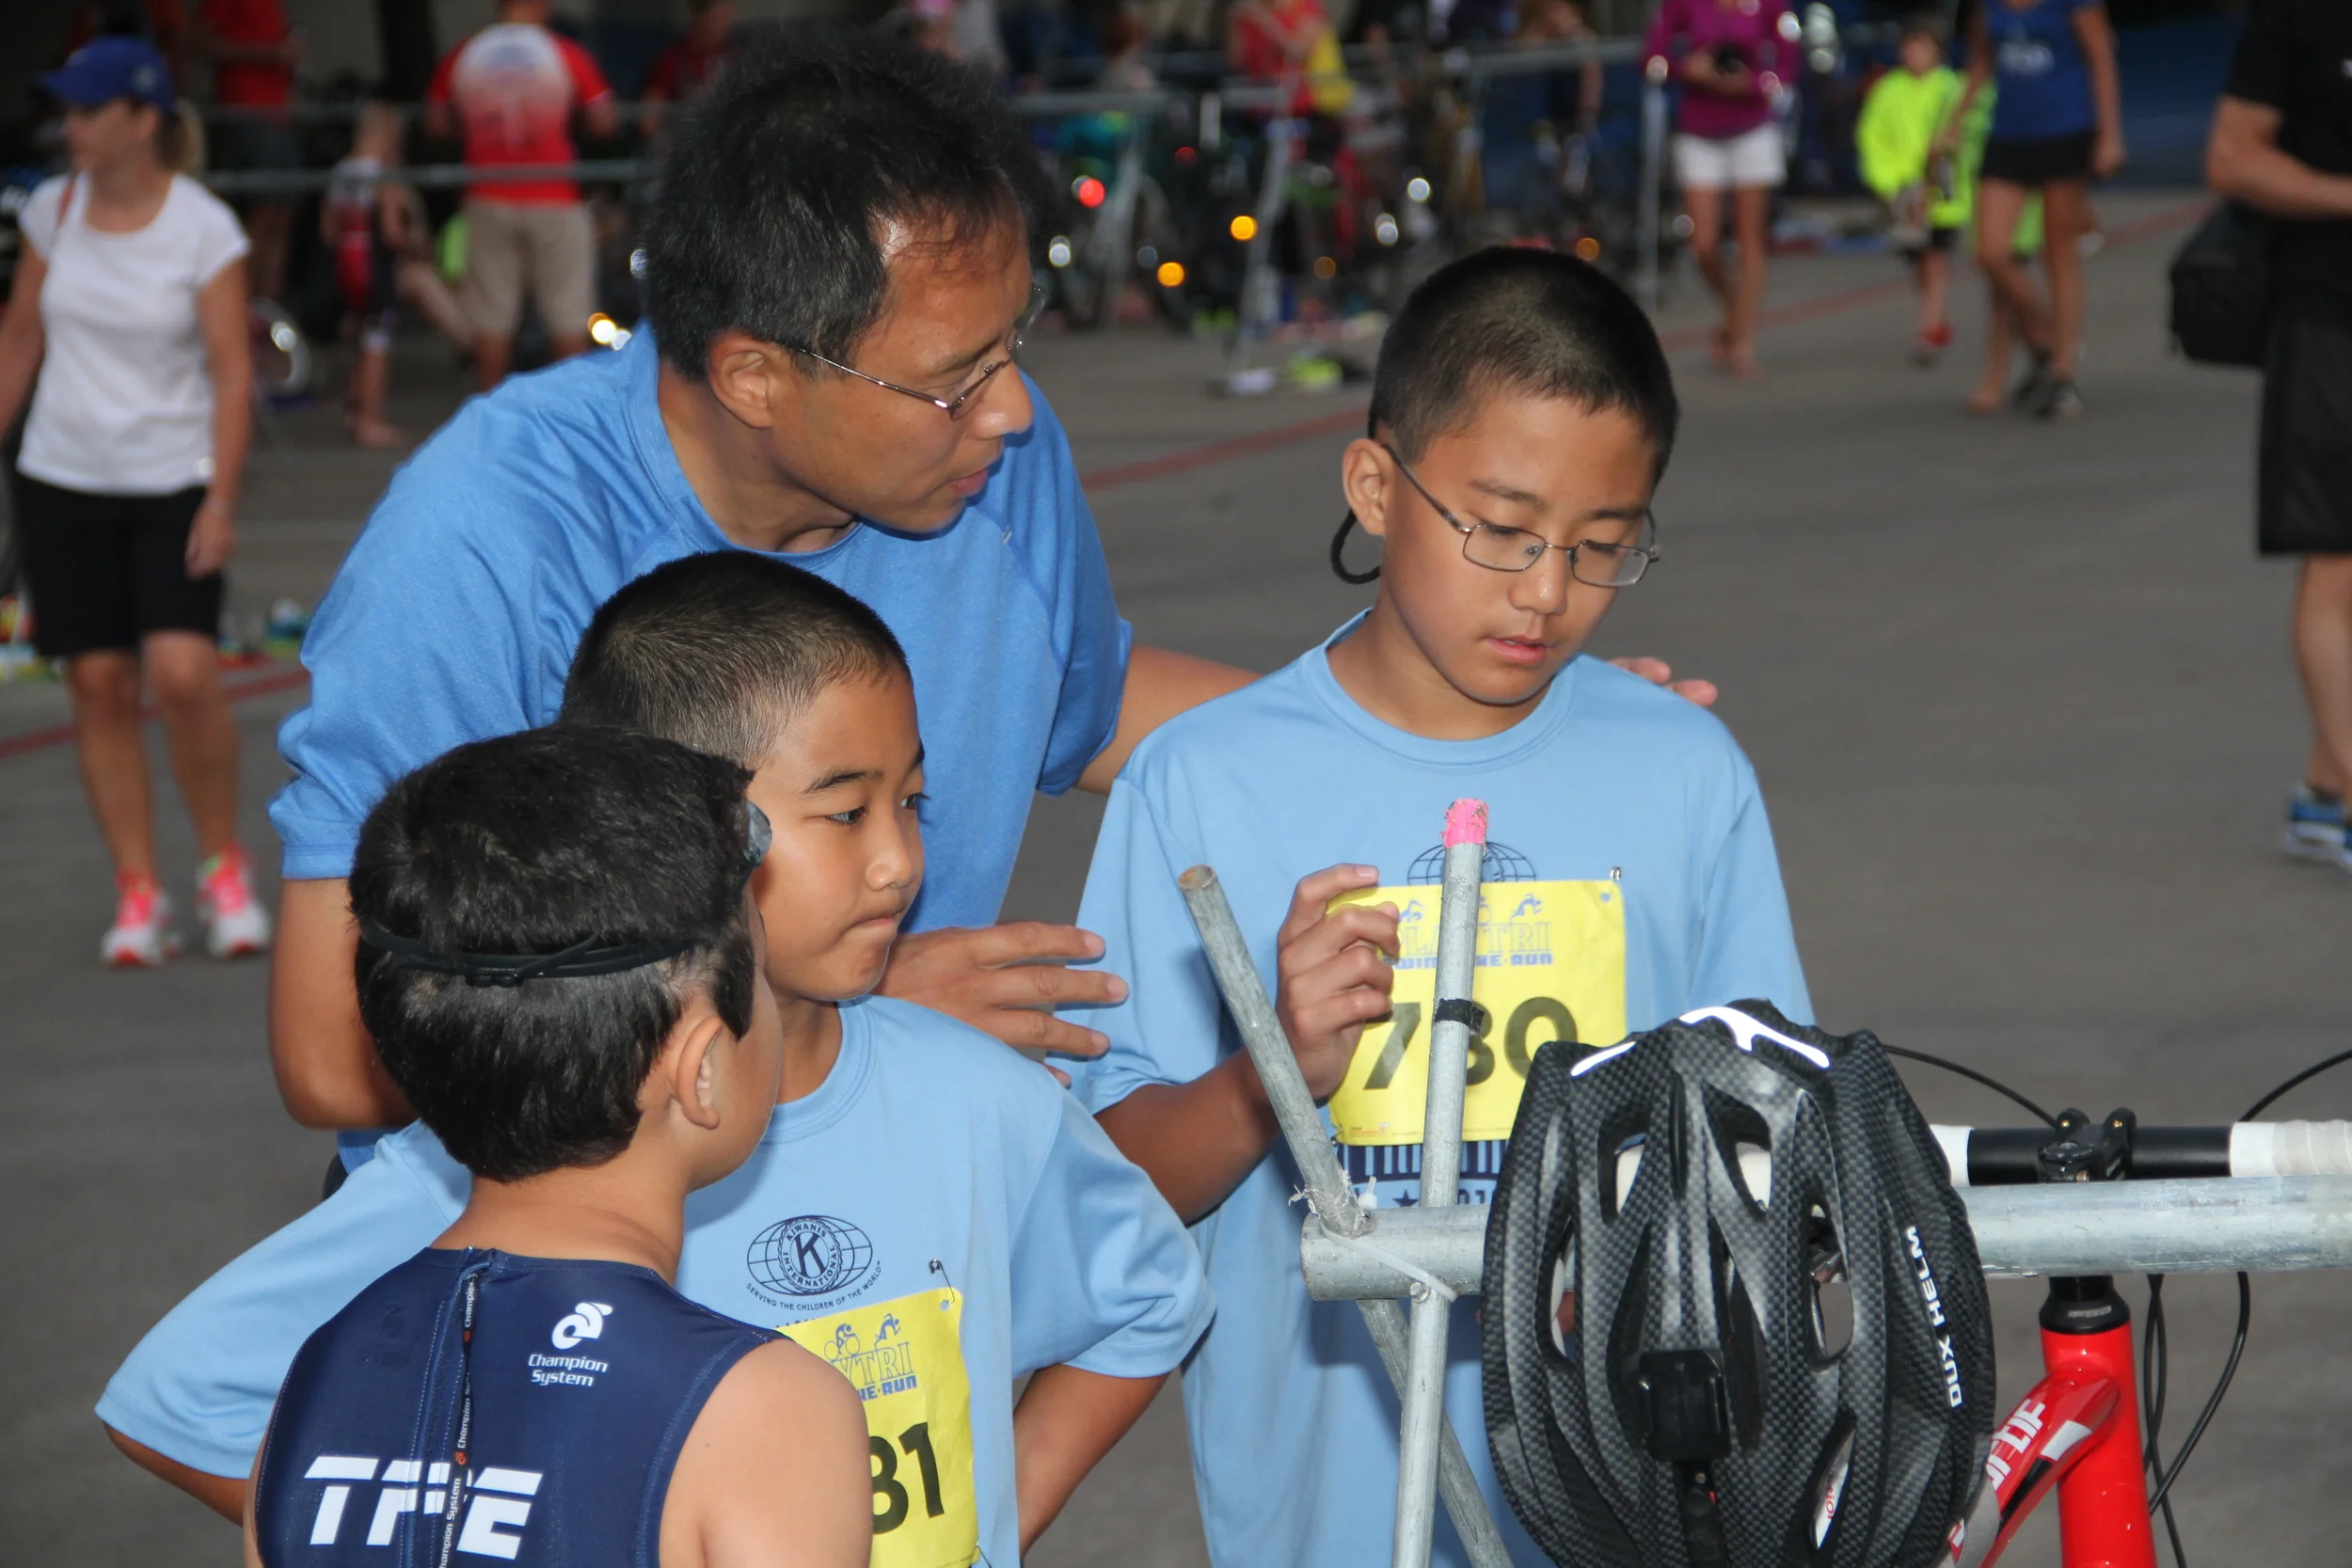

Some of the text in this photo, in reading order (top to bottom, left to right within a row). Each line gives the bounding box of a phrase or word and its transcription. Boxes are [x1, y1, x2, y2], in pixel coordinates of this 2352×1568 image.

[786, 1223, 827, 1242] KIWANIS
[783, 1245, 837, 1288] INTERNATIONAL
[746, 1283, 777, 1307] SERVING
[780, 1302, 794, 1311] THE
[796, 1301, 834, 1311] CHILDREN
[836, 1296, 847, 1306] OF
[848, 1290, 863, 1300] THE
[1905, 1226, 1963, 1408] DUX HELM
[528, 1354, 608, 1372] Champion
[531, 1370, 595, 1386] System
[457, 1398, 470, 1449] Champion
[438, 1478, 461, 1568] hampion System
